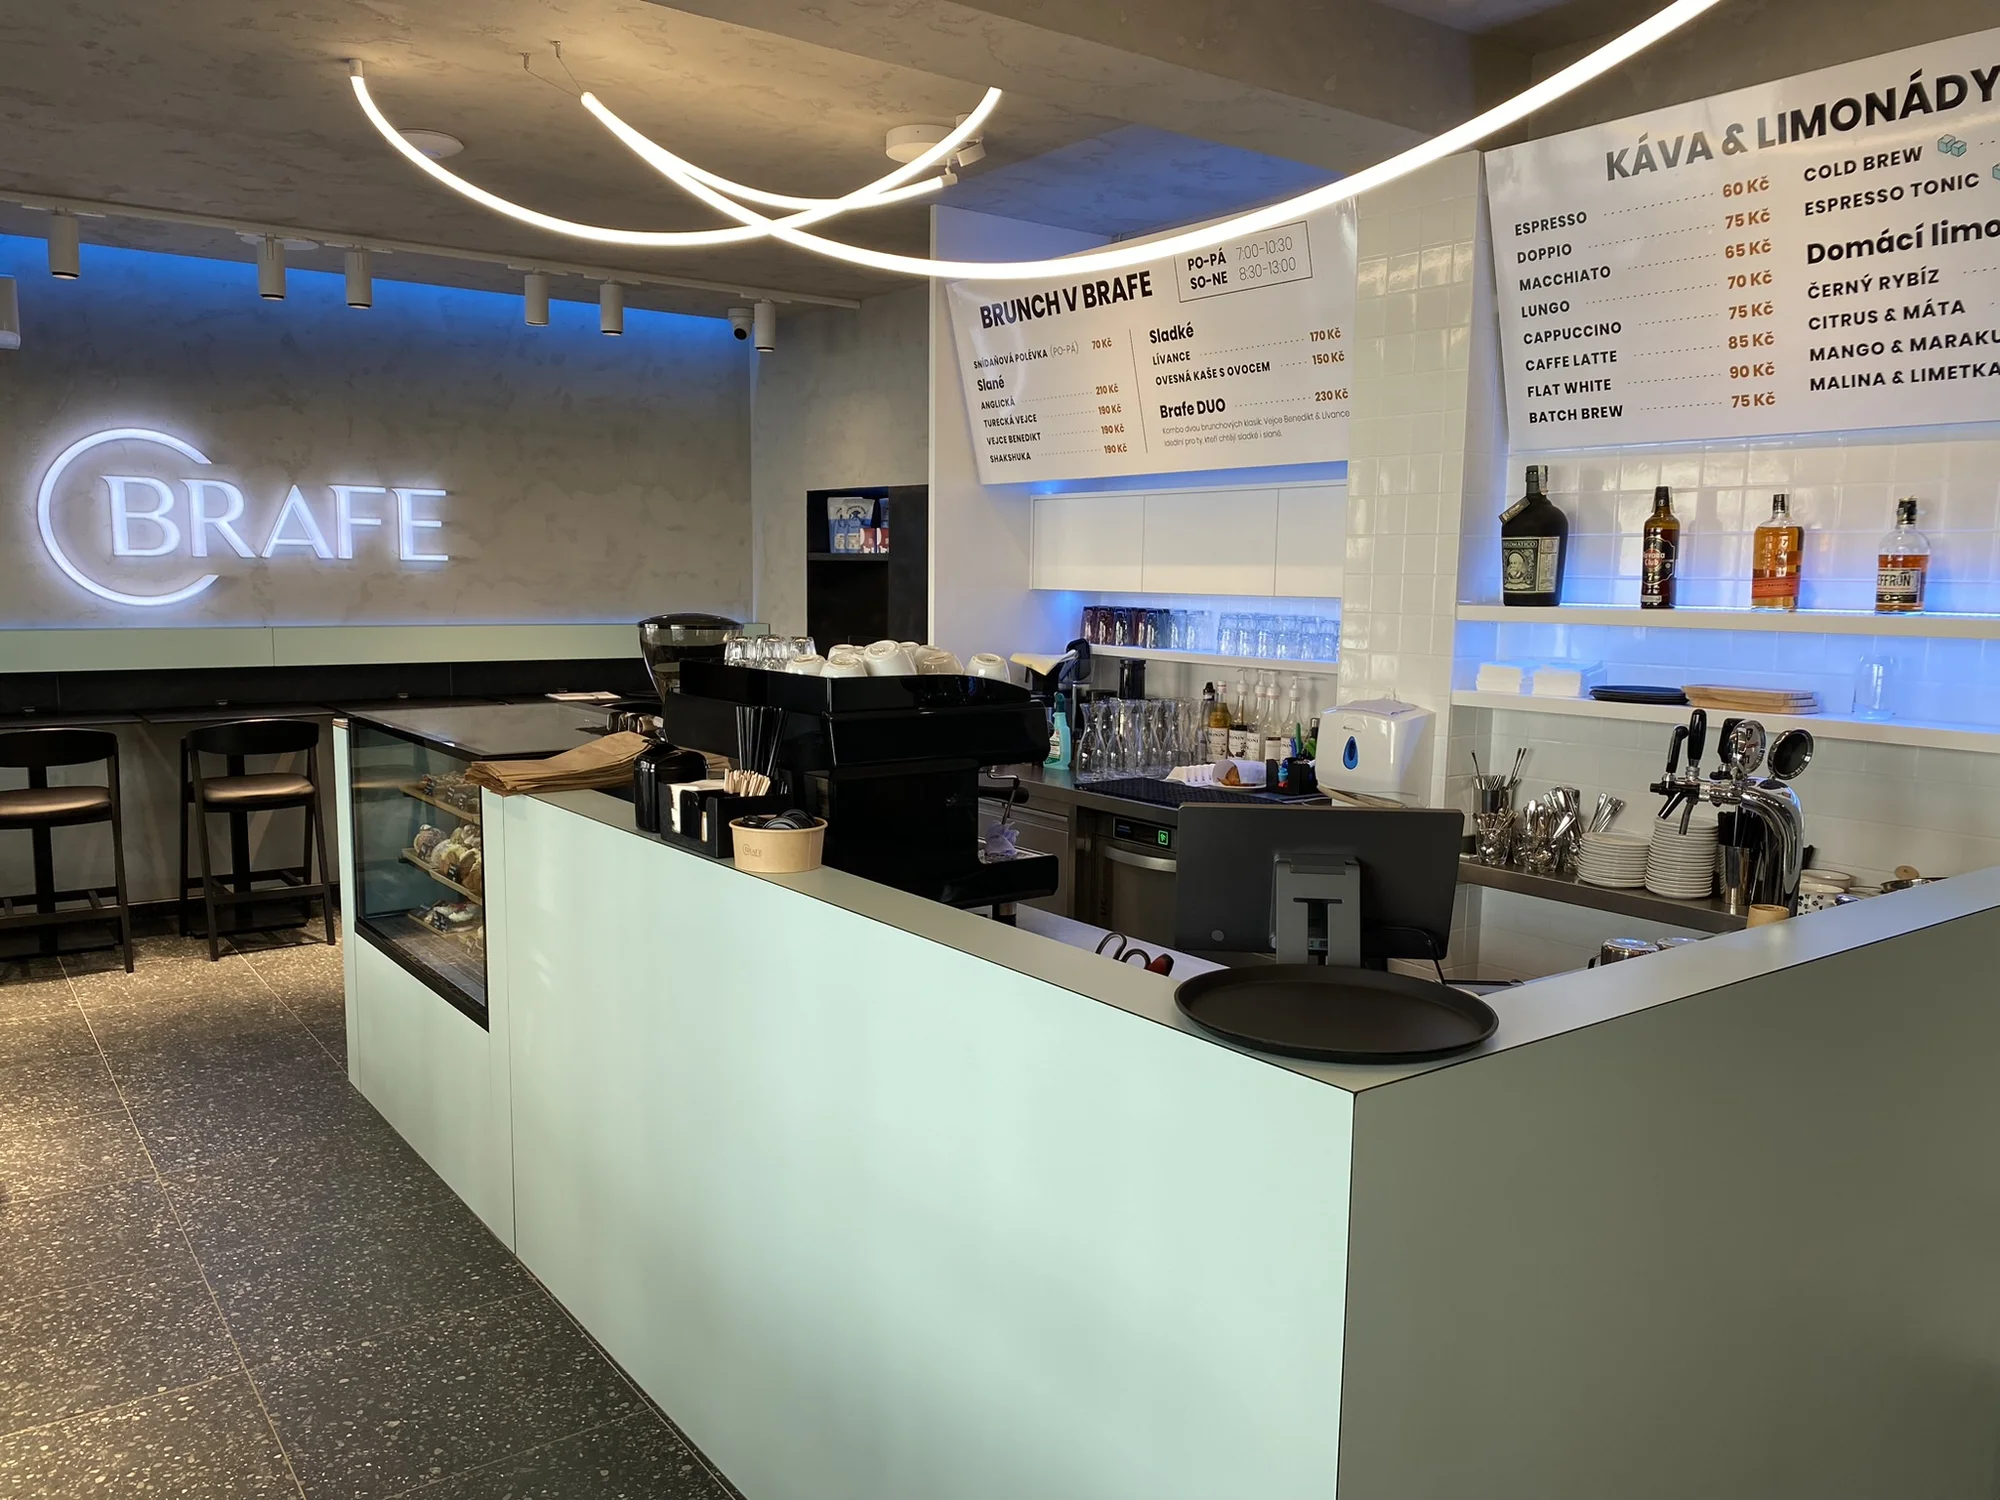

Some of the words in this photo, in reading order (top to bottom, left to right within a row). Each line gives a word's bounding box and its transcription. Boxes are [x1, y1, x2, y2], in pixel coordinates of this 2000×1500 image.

[1606, 131, 1714, 181] KÁVA
[1721, 123, 1749, 156] &
[1757, 65, 2000, 150] LIMONÁDY
[1804, 160, 1857, 182] COLD
[1863, 146, 1923, 171] BREW
[1515, 211, 1587, 236] ESPRESSO
[1722, 182, 1743, 198] 60
[1747, 175, 1770, 194] Kč
[1805, 186, 1904, 216] ESPRESSO
[1910, 172, 1980, 197] TONIC
[1187, 248, 1227, 271] PO-PÁ
[1235, 235, 1294, 261] 7:00-10:30
[1517, 243, 1572, 264] DOPPIO
[1725, 213, 1745, 230] 75
[1748, 208, 1771, 225] Kč
[1807, 222, 1924, 265] Domácí
[1190, 271, 1228, 291] SO-NE
[1238, 256, 1297, 281] 8:30-13:00
[1519, 266, 1611, 292] MACCHIATO
[1725, 243, 1745, 259] 65
[1749, 238, 1772, 255] Kč
[1807, 274, 1873, 299] ČERNÝ
[1879, 266, 1940, 291] RYBÍZ
[979, 289, 1061, 329] BRUNCH
[1062, 286, 1078, 312] V
[1082, 270, 1153, 309] BRAFE
[1521, 300, 1570, 318] LUNGO
[1727, 274, 1747, 289] 70
[1750, 269, 1773, 286] Kč
[1523, 321, 1622, 345] CAPPUCCINO
[1728, 305, 1748, 320] 75
[1751, 300, 1774, 317] Kč
[1808, 310, 1878, 330] CITRUS
[1884, 308, 1896, 322] &
[1903, 298, 1965, 320] MÁTA
[1149, 321, 1194, 344] Sladké
[1152, 351, 1191, 366] LÍVANCE
[1309, 330, 1326, 342] 170
[1327, 327, 1341, 340] Kč
[1810, 341, 1885, 361] MANGO
[1891, 339, 1904, 353] &
[973, 353, 1015, 370] SNÍDAŇOVÁ
[1014, 349, 1049, 363] POLÉVKA
[1049, 340, 1080, 359] (PO-PÁ)
[1091, 340, 1101, 350] 70
[1101, 338, 1113, 348] Kč
[1155, 369, 1192, 386] OVESNÁ
[1193, 365, 1218, 381] KAŠE
[1219, 367, 1225, 378] S
[1227, 361, 1271, 376] OVOCEM
[1312, 353, 1330, 365] 150
[1330, 350, 1345, 363] Kč
[1525, 356, 1570, 371] CAFFE
[1573, 350, 1617, 367] LATTE
[1728, 335, 1749, 349] 85
[1752, 331, 1775, 347] Kč
[977, 374, 1005, 392] Slané
[1527, 383, 1560, 398] FLAT
[1564, 379, 1611, 395] WHITE
[1729, 365, 1749, 379] 90
[1753, 361, 1775, 377] Kč
[1810, 372, 1886, 391] MALINA
[1892, 371, 1904, 384] &
[1911, 362, 2000, 383] LIMETKA
[981, 395, 1016, 410] ANGLICKÁ
[1095, 386, 1108, 396] 210
[1108, 383, 1119, 394] Kč
[1159, 401, 1195, 419] Brafe
[1196, 398, 1226, 415] DUO
[1314, 390, 1333, 402] 230
[1334, 388, 1349, 401] Kč
[1529, 408, 1577, 424] BATCH
[1581, 405, 1623, 420] BREW
[1731, 394, 1751, 408] 75
[1754, 391, 1776, 406] Kč
[983, 414, 1015, 428] TURECKÁ
[1015, 413, 1038, 425] VEJCE
[1097, 405, 1111, 416] 190
[1110, 403, 1122, 414] Kč
[1315, 411, 1320, 420] &
[987, 434, 1008, 446] VEJCE
[1008, 432, 1041, 444] BENEDIKT
[1100, 425, 1114, 435] 190
[1113, 423, 1125, 434] Kč
[989, 451, 1032, 463] SHAKSHUKA
[1103, 445, 1116, 454] 190
[1116, 443, 1128, 453] Kč
